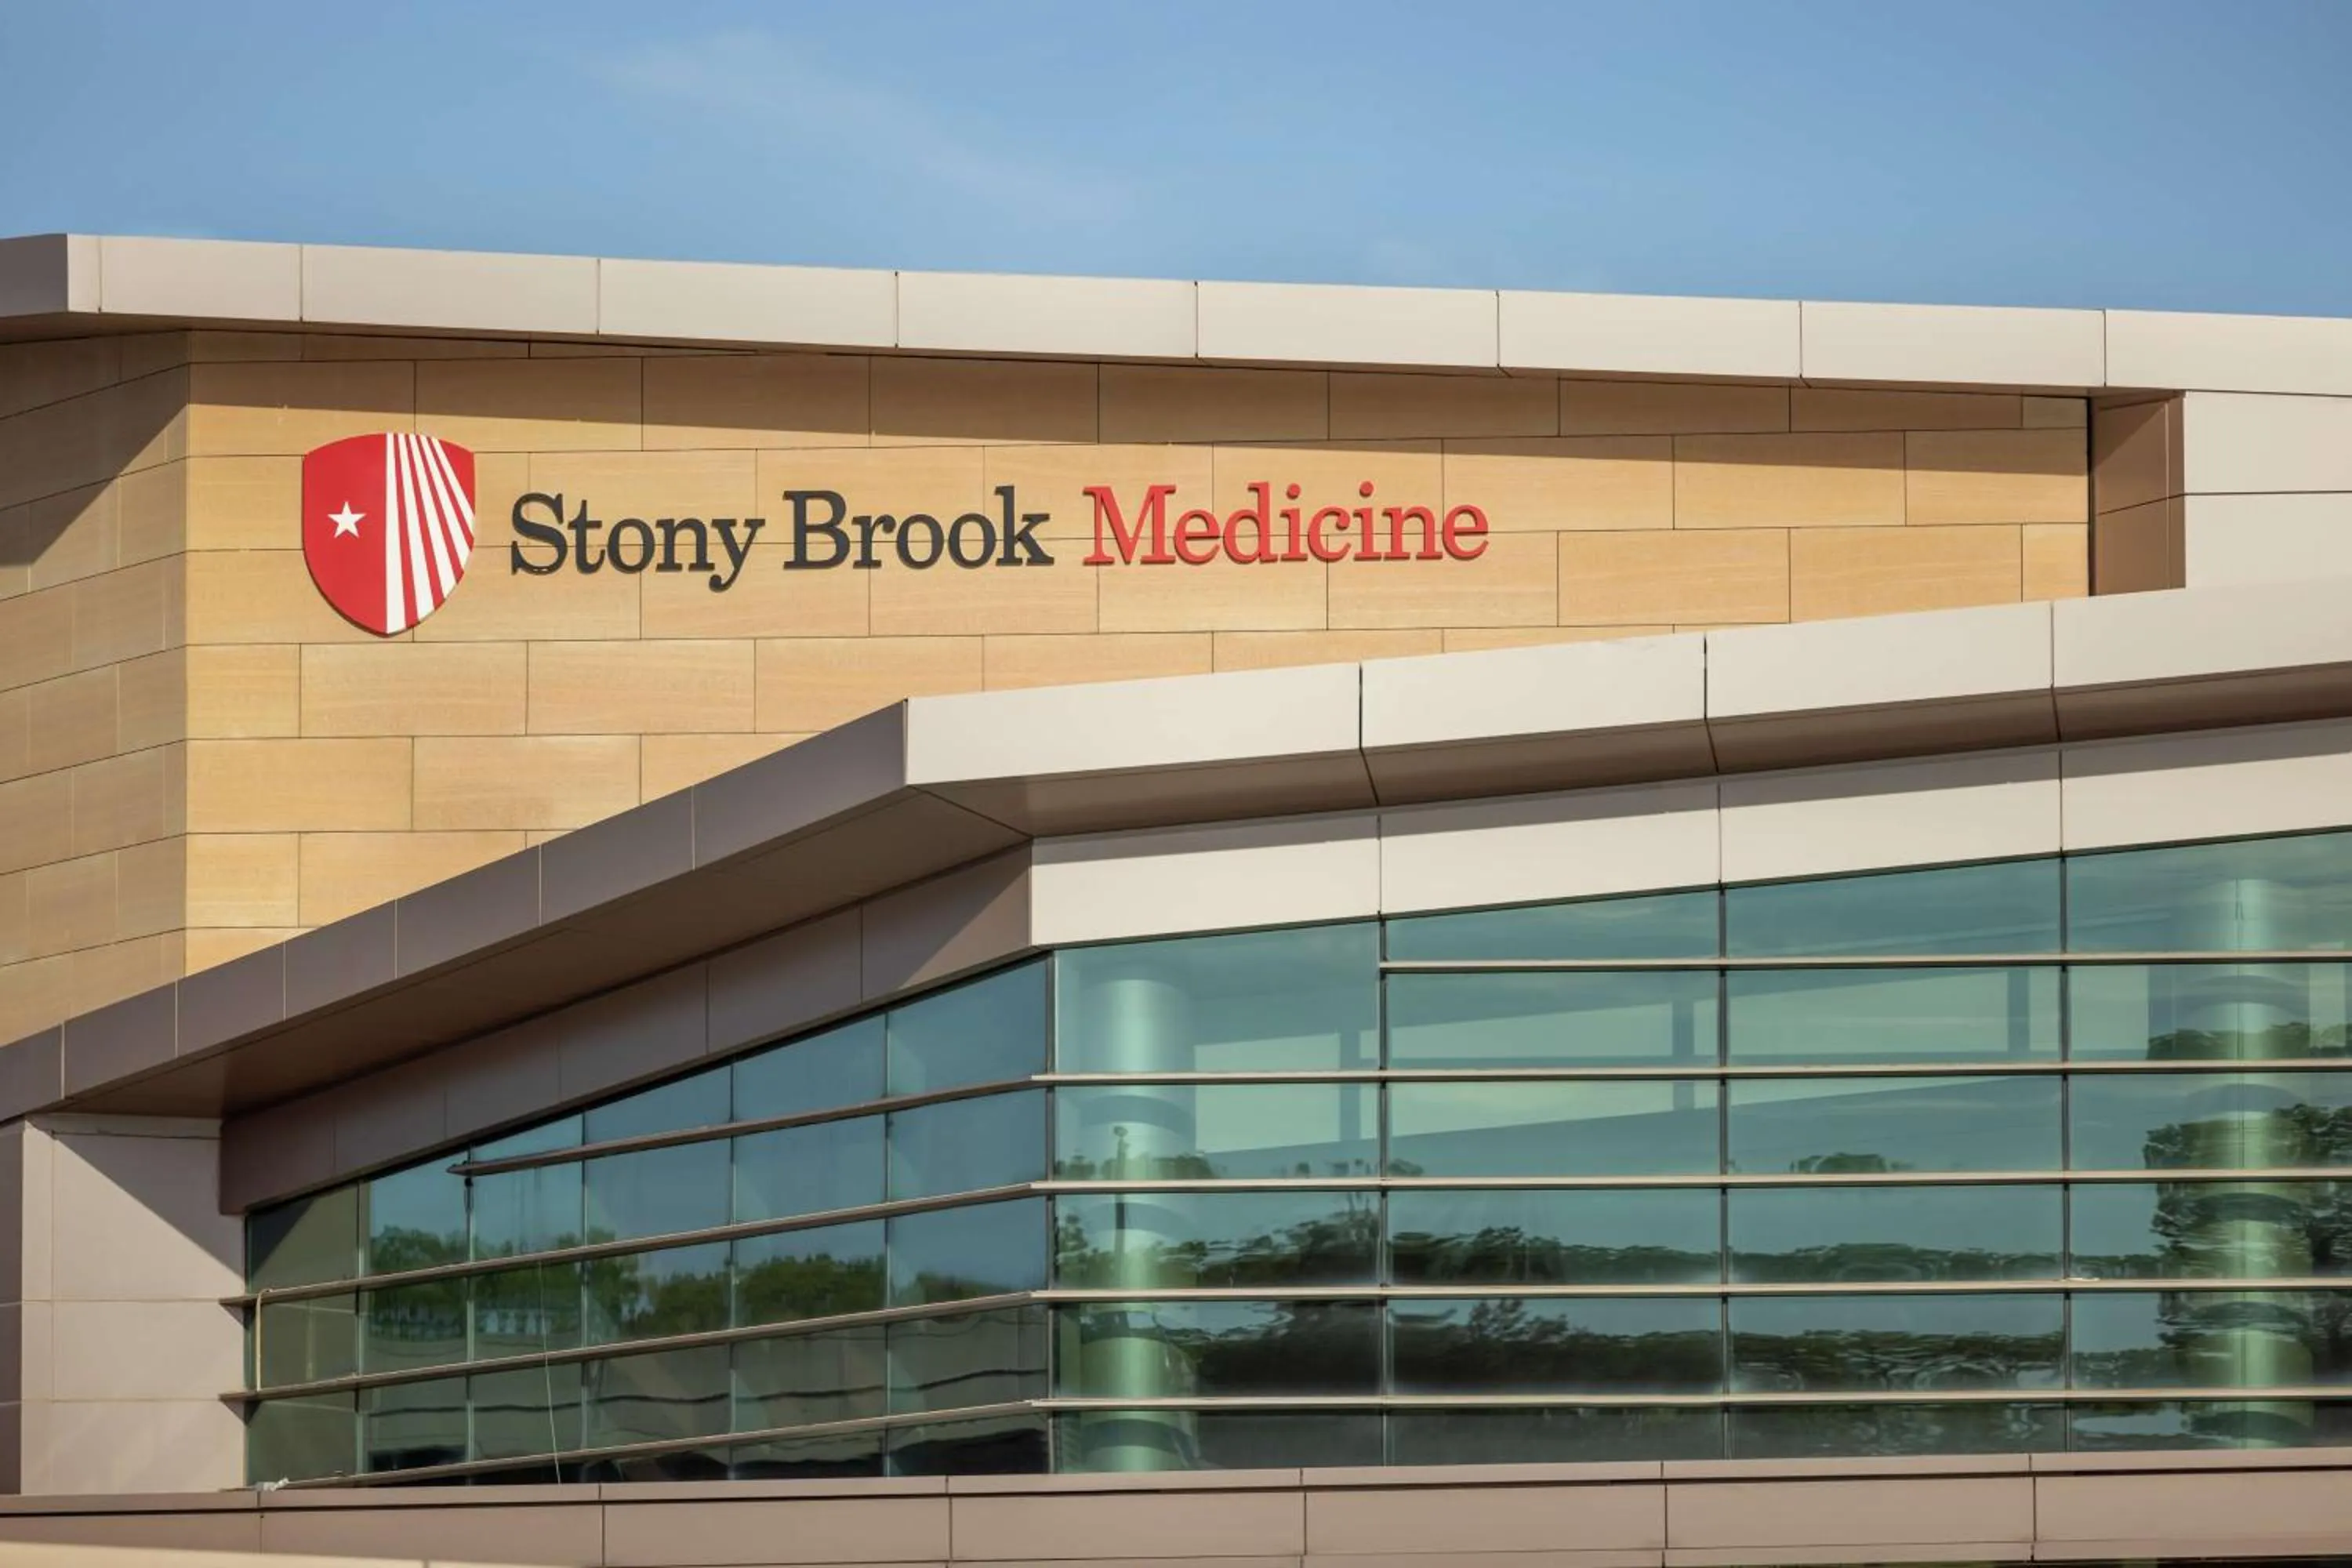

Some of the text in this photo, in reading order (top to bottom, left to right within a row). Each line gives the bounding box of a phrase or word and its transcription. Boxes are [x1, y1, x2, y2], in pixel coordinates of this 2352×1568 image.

[511, 481, 1488, 592] Stony Brook Medicine
